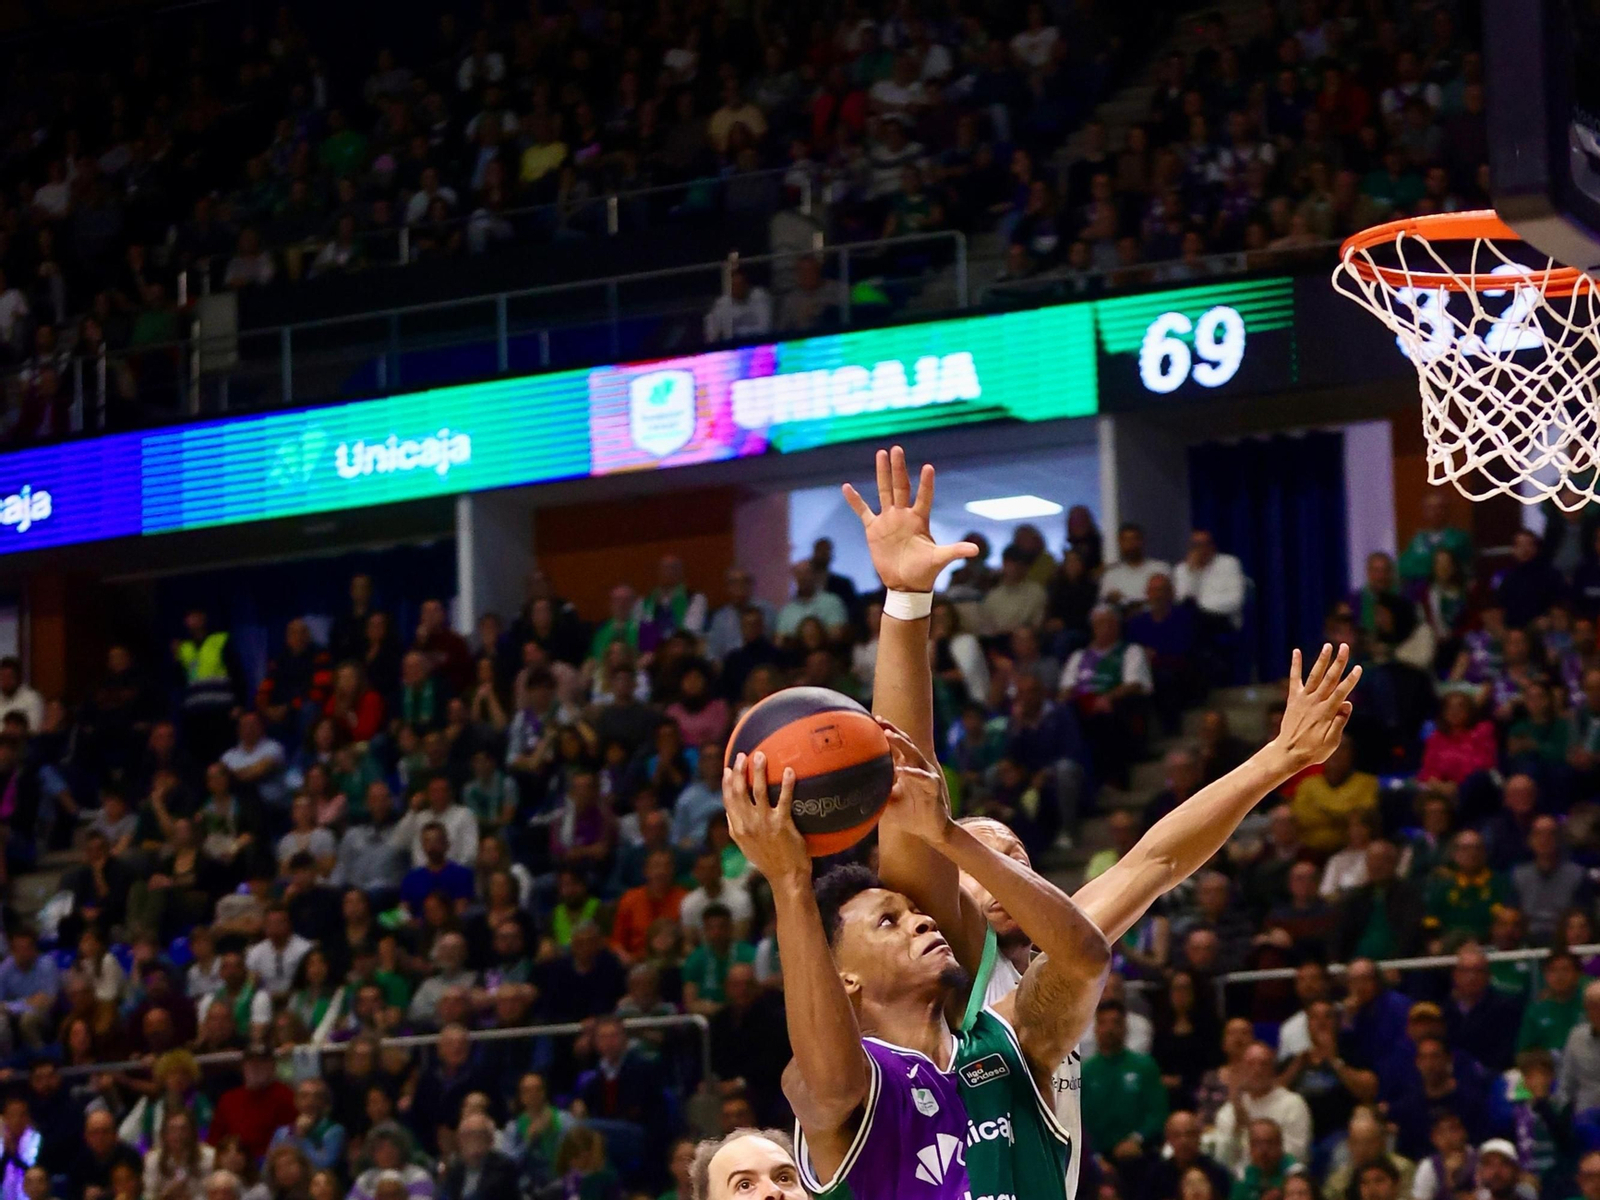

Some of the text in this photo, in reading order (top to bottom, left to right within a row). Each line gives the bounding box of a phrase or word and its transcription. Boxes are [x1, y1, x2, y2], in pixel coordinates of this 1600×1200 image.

[1139, 306, 1246, 392] 69
[335, 427, 472, 479] Unicaja
[0, 484, 52, 533] aja
